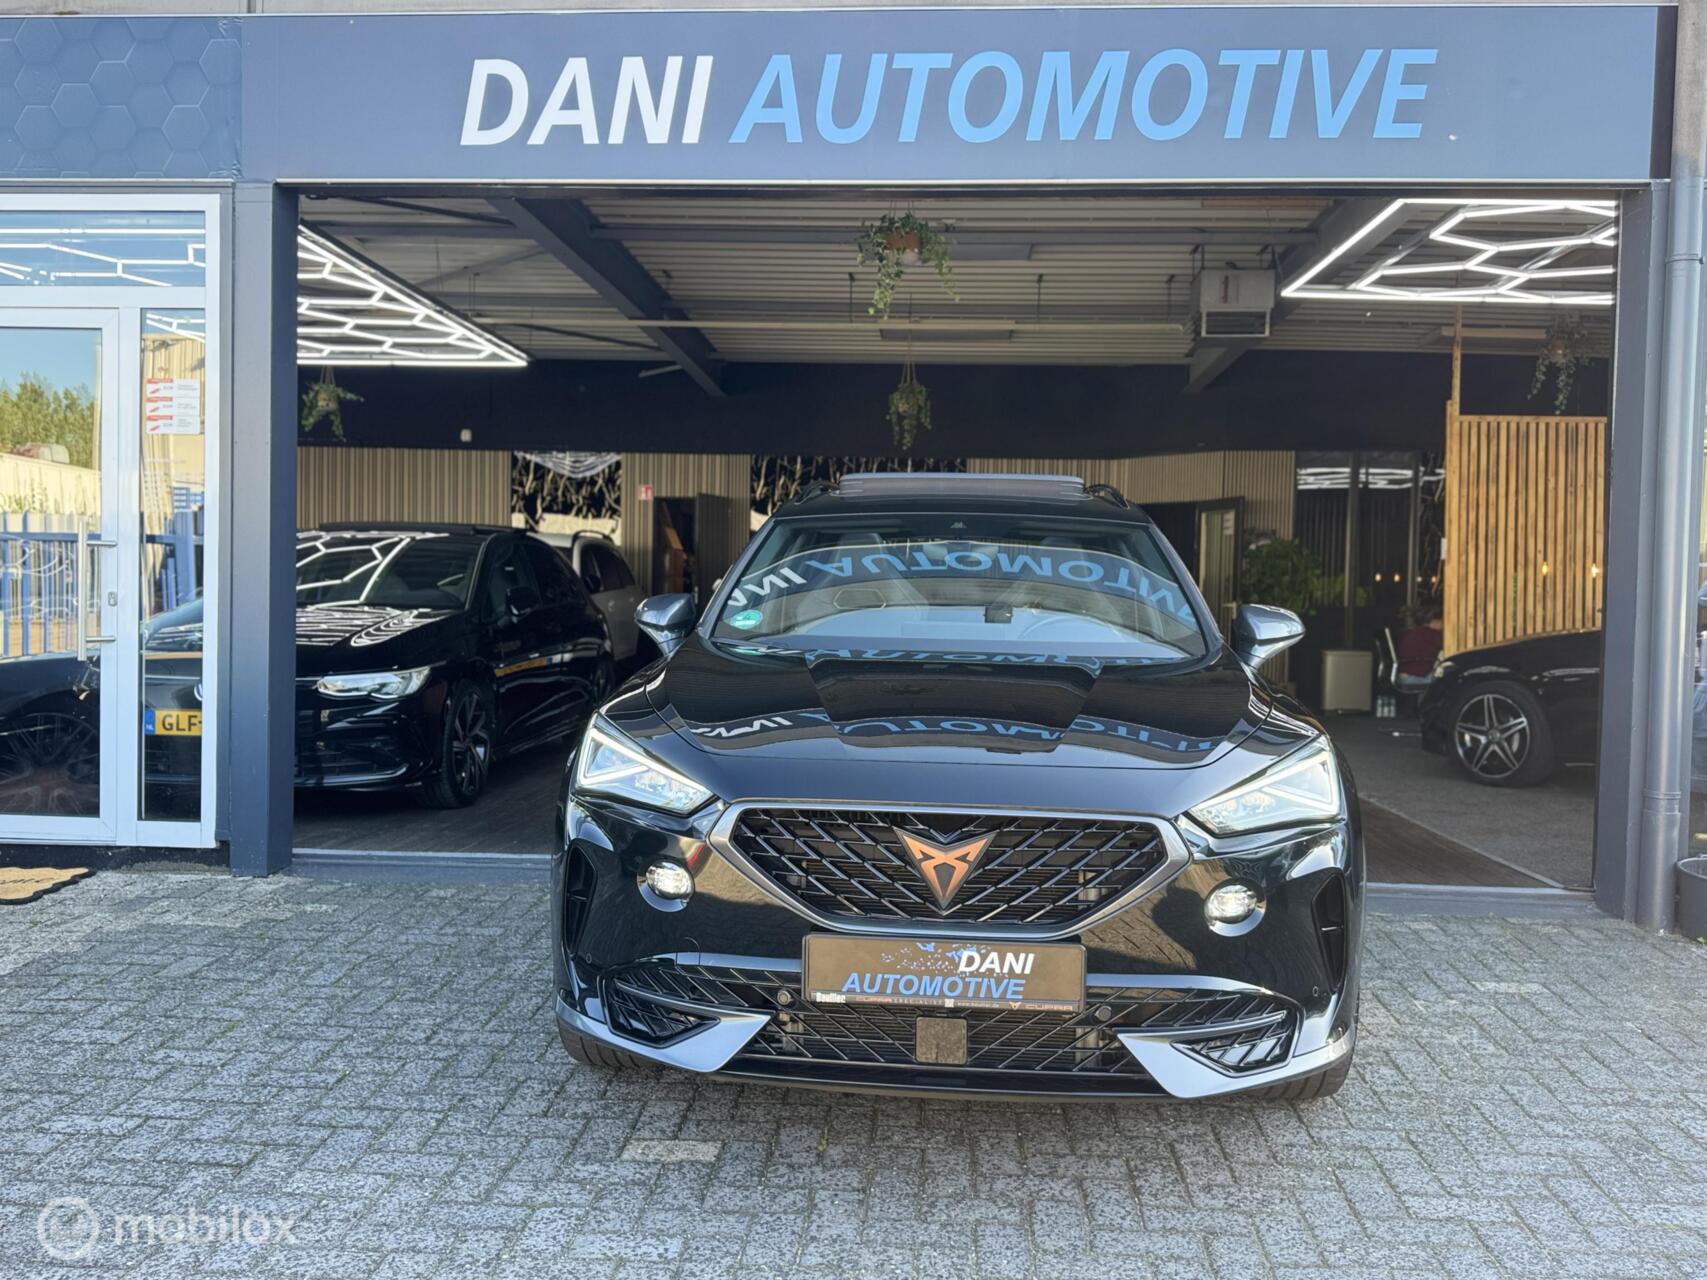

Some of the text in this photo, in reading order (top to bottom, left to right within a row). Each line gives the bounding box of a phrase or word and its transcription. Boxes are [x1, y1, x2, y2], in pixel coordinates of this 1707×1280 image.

[460, 48, 1439, 145] DANI AUTOMOTIVE
[958, 951, 1035, 975] DANI
[842, 972, 1026, 1000] AUTOMOTIVE
